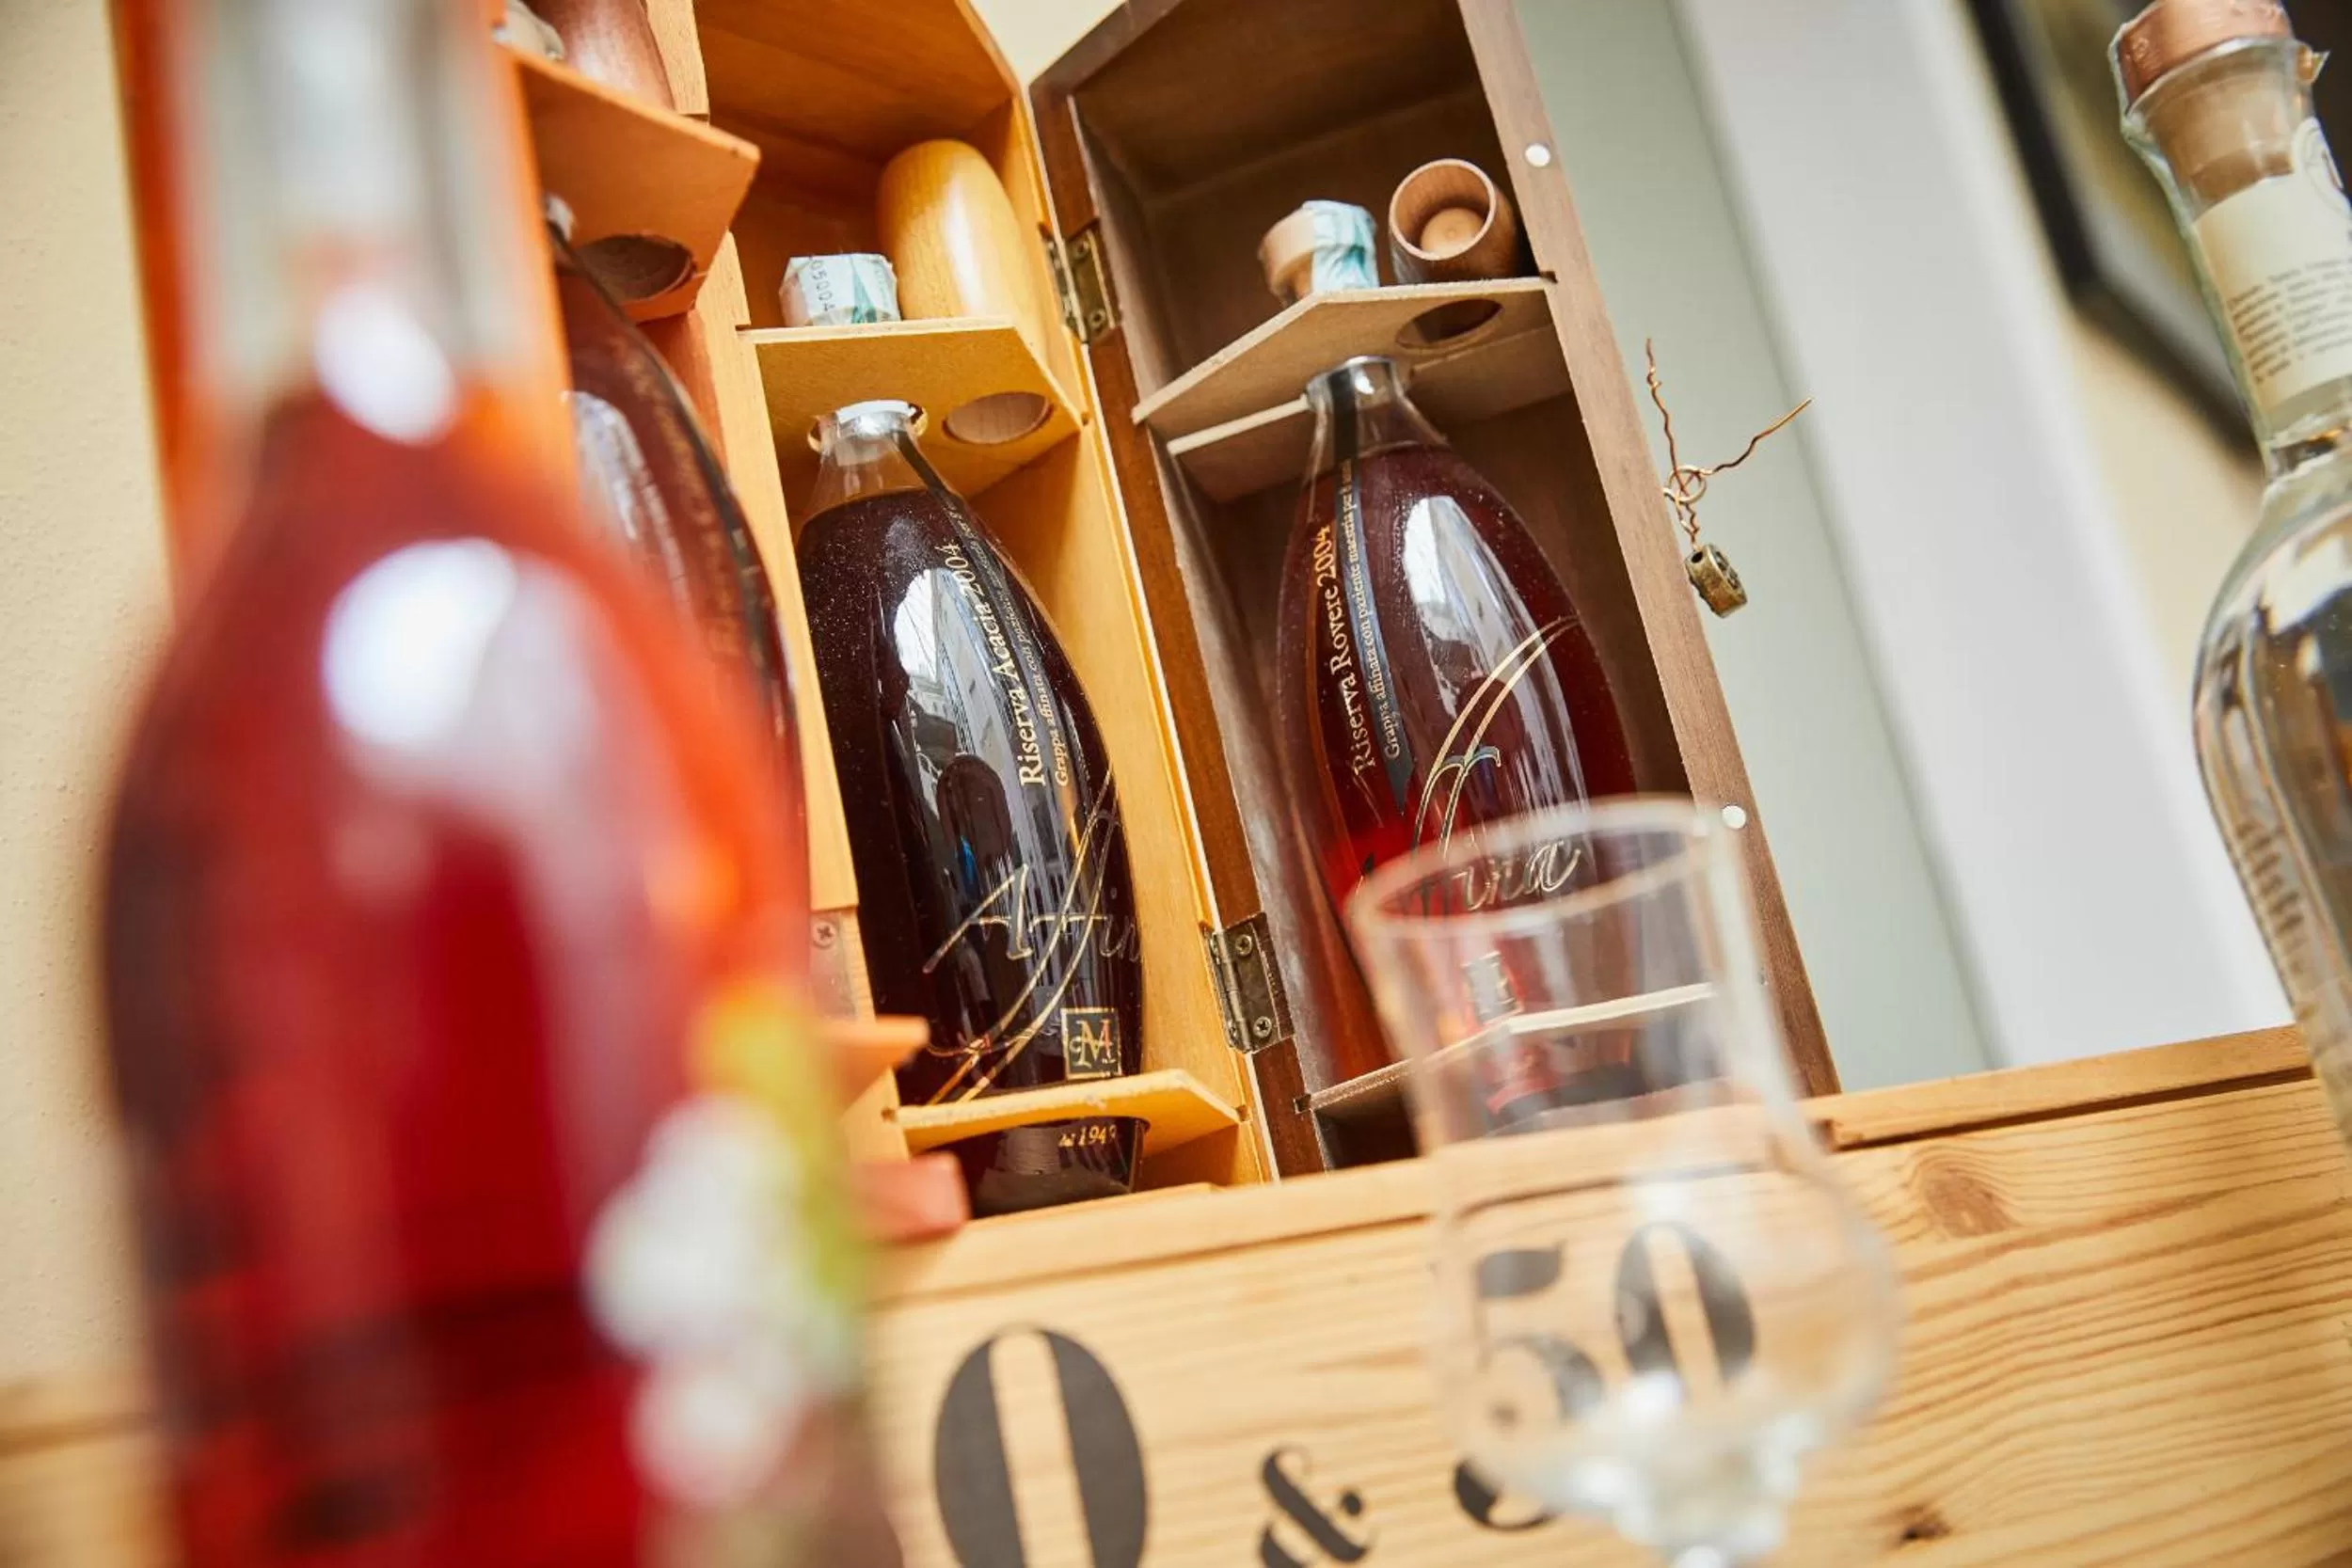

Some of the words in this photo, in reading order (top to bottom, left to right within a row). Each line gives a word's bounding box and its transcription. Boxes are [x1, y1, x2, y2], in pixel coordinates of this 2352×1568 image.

[935, 542, 984, 597] 2004
[1313, 524, 1338, 590] 2004
[1351, 562, 1373, 619] paziente
[975, 603, 1019, 681] Acacia
[1021, 645, 1037, 671] con
[1325, 585, 1352, 676] Rovere
[1360, 620, 1374, 646] con
[1007, 686, 1046, 785] Riserva
[1343, 671, 1376, 775] Riserva
[1377, 702, 1401, 758] Grappa
[1050, 728, 1069, 785] Grappa
